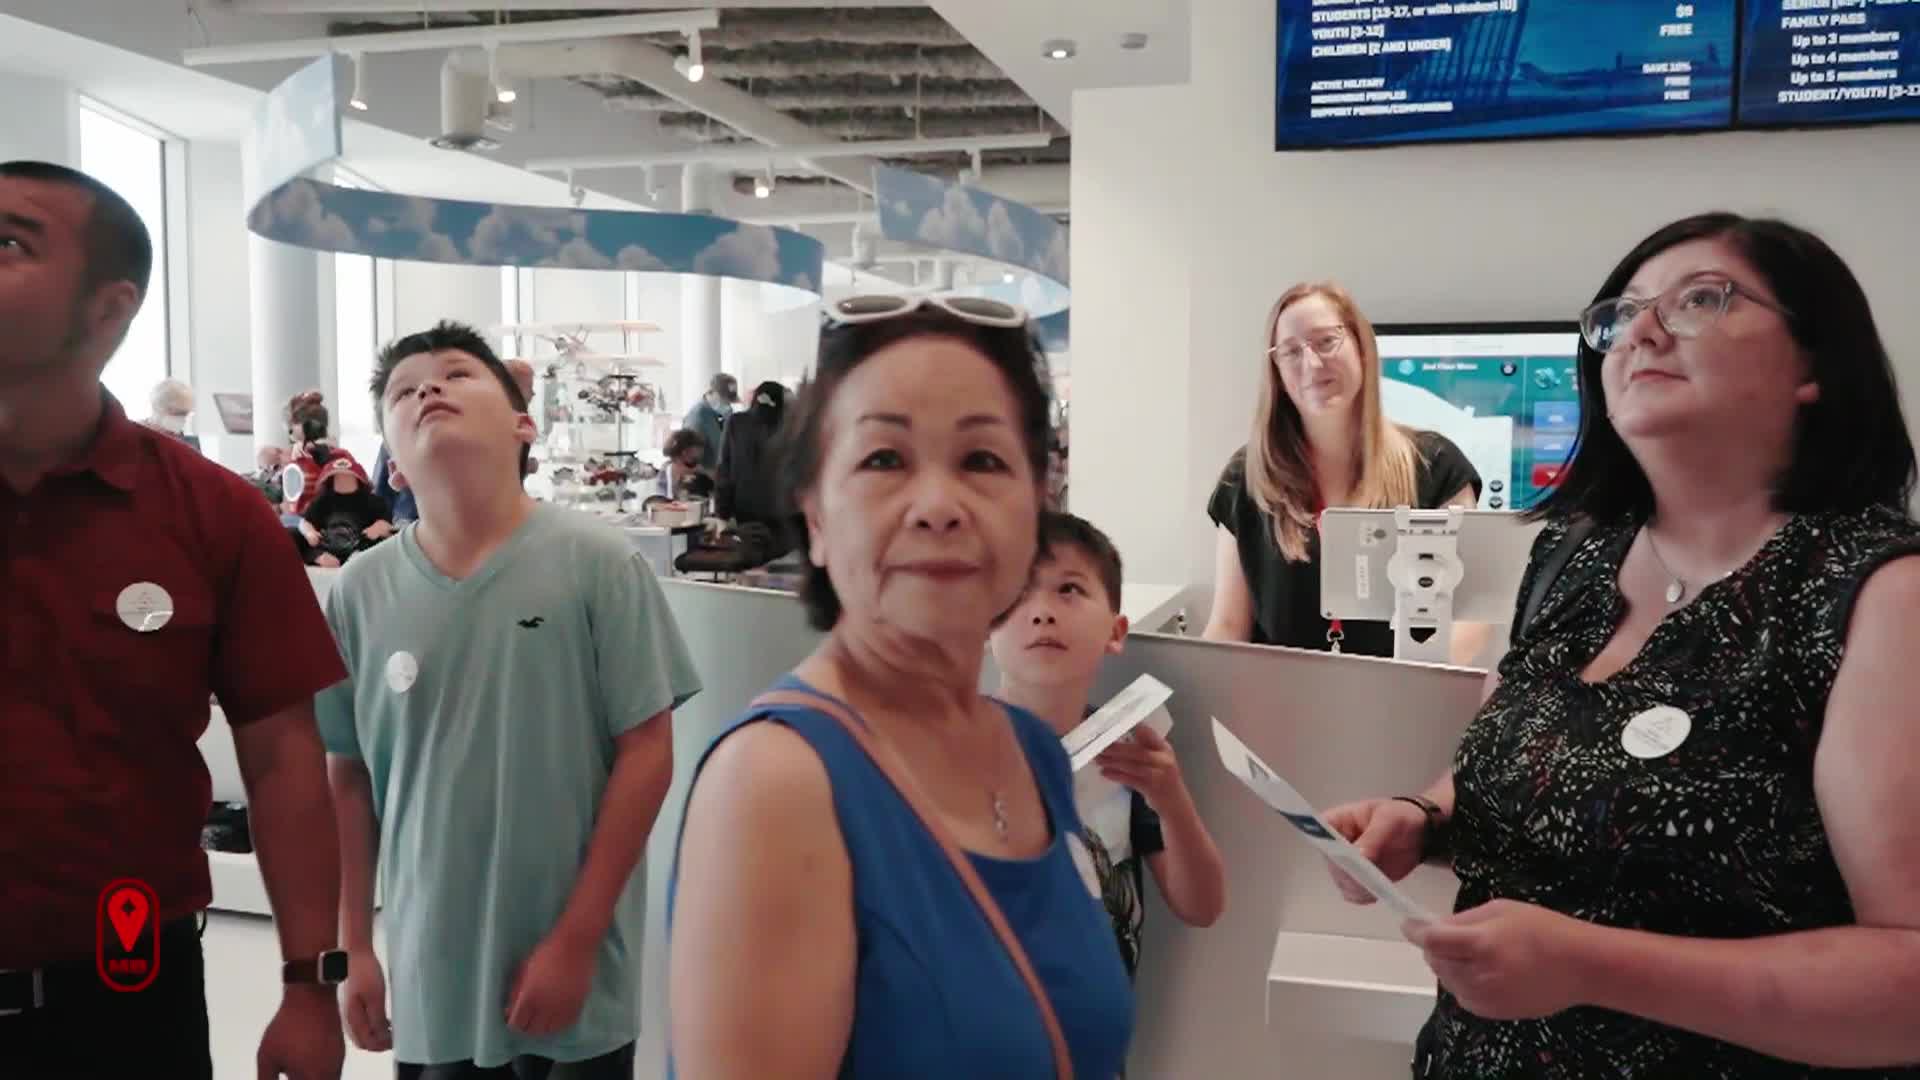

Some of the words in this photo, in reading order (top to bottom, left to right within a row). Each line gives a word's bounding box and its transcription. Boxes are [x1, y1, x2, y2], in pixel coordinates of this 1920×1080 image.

[1311, 8, 1371, 22] STUDENTS
[1412, 7, 1425, 16] or
[1427, 4, 1452, 15] with
[1454, 1, 1498, 13] student
[1781, 15, 1829, 28] FAMILY
[1830, 12, 1866, 26] PASS
[1311, 26, 1350, 40] YOUTH
[1659, 23, 1693, 36] FREE
[1792, 34, 1811, 49] Up
[1812, 35, 1826, 46] to
[1827, 32, 1838, 45] 3
[1839, 30, 1900, 45] members
[1311, 43, 1367, 57] CHILDREN
[1381, 40, 1405, 53] AND
[1791, 53, 1810, 68] Up
[1811, 54, 1825, 64] to
[1826, 51, 1837, 63] 4
[1838, 49, 1899, 64] members
[1311, 80, 1343, 90] ACTIVE
[1344, 77, 1385, 89] MILITARY
[1664, 76, 1690, 86] FREE
[1791, 71, 1809, 86] Up
[1810, 72, 1825, 83] to
[1825, 70, 1836, 82] 5
[1837, 67, 1898, 82] members
[1664, 90, 1690, 100] FREE
[1777, 86, 1888, 104] STUDENT/YOUTH
